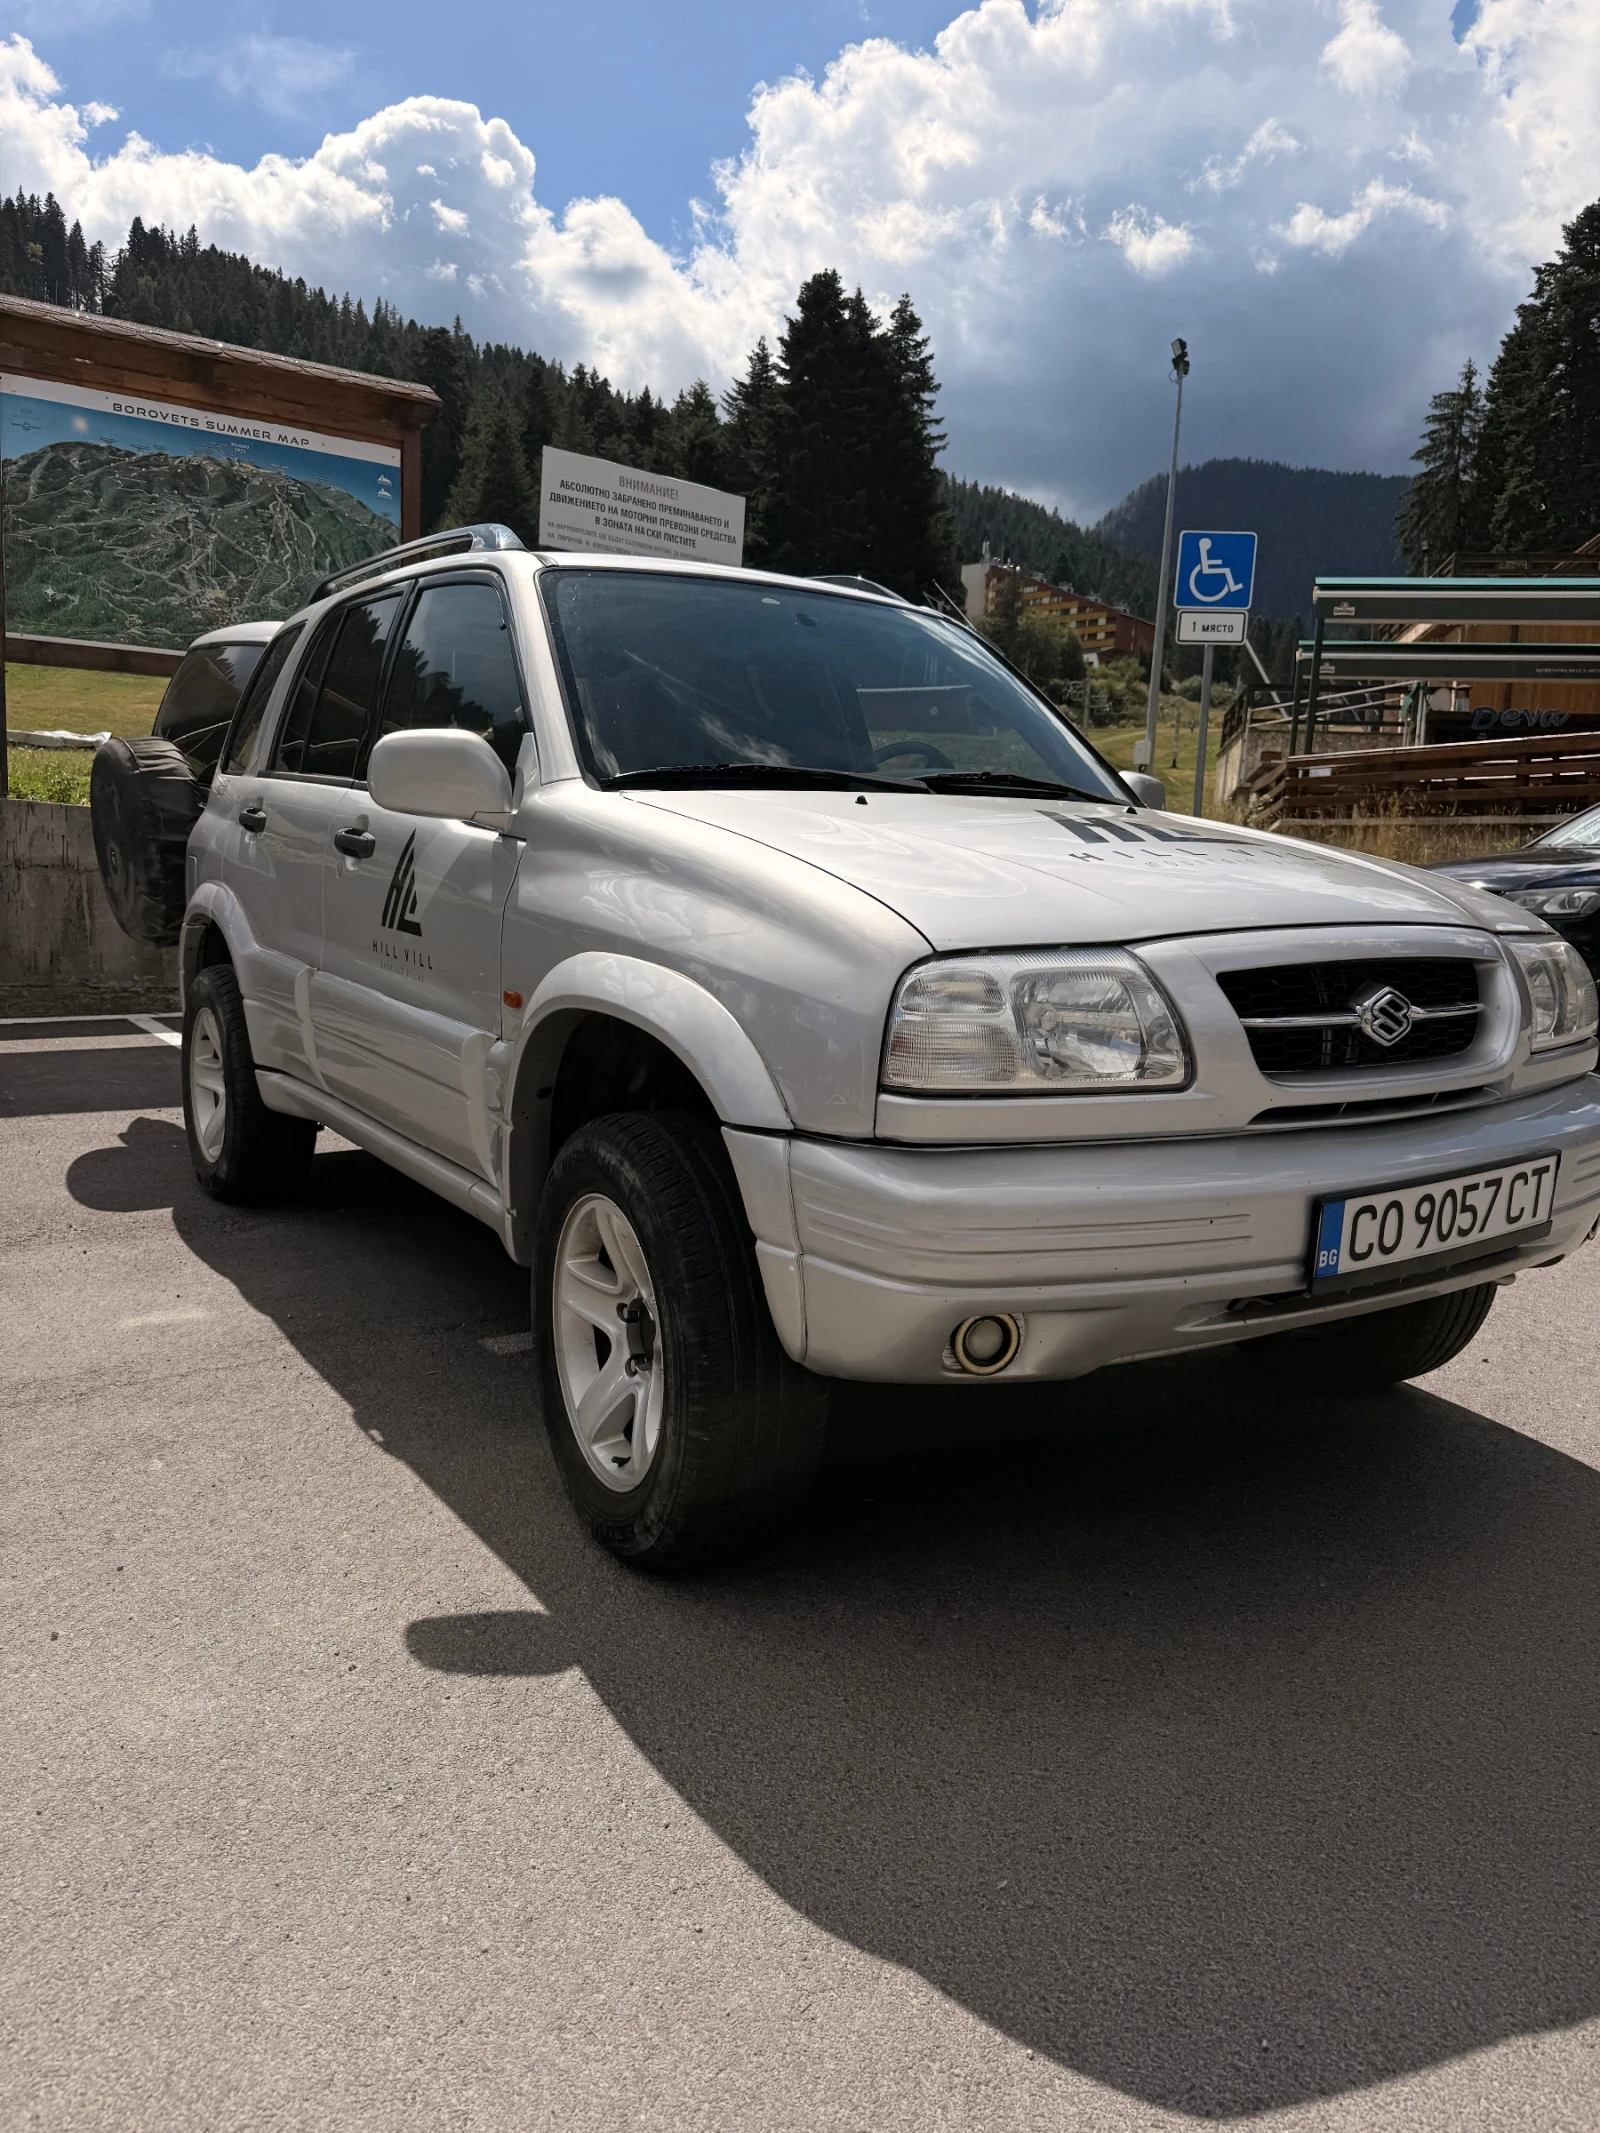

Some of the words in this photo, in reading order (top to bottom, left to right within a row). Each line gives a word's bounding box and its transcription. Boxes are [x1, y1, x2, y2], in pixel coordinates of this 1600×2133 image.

[113, 402, 200, 427] BOROVETS
[205, 420, 271, 440] SUMMER
[277, 433, 310, 446] MAP
[559, 479, 610, 500] АБСОЛЮТНО
[612, 492, 657, 511] ЗАБРАНЕНО
[658, 503, 722, 527] ПРЕМИНАВАНЕТО
[723, 520, 729, 529] И
[618, 476, 679, 501] ВНИМАНИЕ!
[549, 492, 606, 513] ДВИЖЕНИЕТО
[608, 504, 619, 516] НА
[620, 508, 658, 526] МОТОРНИ
[659, 518, 699, 537] ПРЕВОЗНИ
[700, 529, 737, 545] СРЕДСТВА
[595, 516, 601, 525] В
[602, 518, 633, 534] ЗОНАТА
[634, 525, 646, 537] НА
[646, 529, 661, 540] СКИ
[663, 532, 697, 549] ПИСТИТЕ
[1192, 621, 1197, 632] 1
[1471, 706, 1571, 730] Deva
[372, 938, 398, 959] HILL
[404, 948, 433, 970] VILL
[1349, 1200, 1404, 1262] CO
[1414, 1176, 1503, 1249] 9057
[1506, 1165, 1550, 1225] CT
[1318, 1249, 1338, 1268] BG
